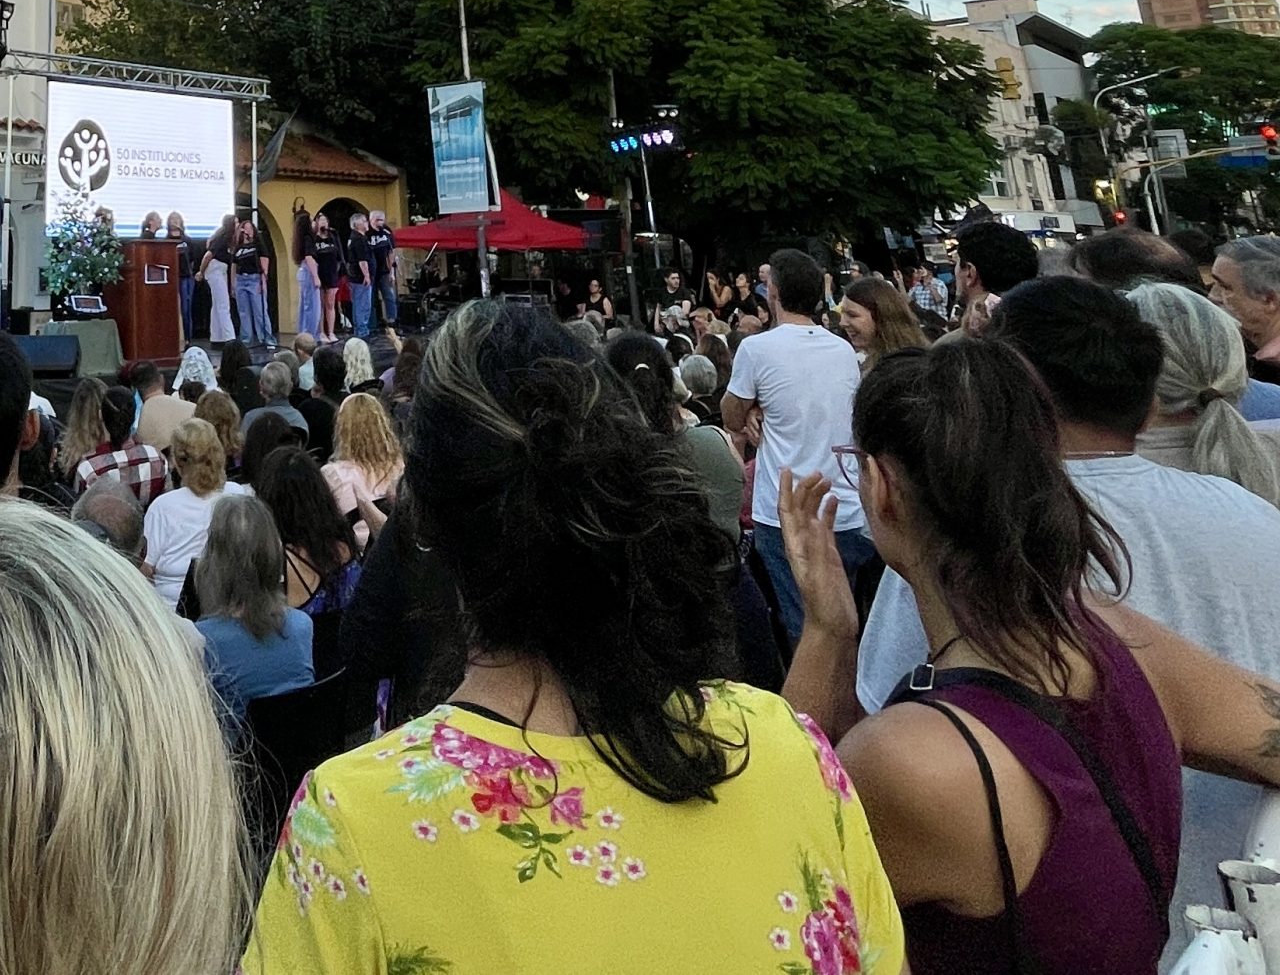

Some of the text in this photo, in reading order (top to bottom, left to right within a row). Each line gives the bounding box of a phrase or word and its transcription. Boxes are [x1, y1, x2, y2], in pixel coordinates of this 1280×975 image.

[116, 148, 202, 165] 50 INSTITUCIONES
[117, 162, 225, 181] 50 AÑOS DE MEMORIA
